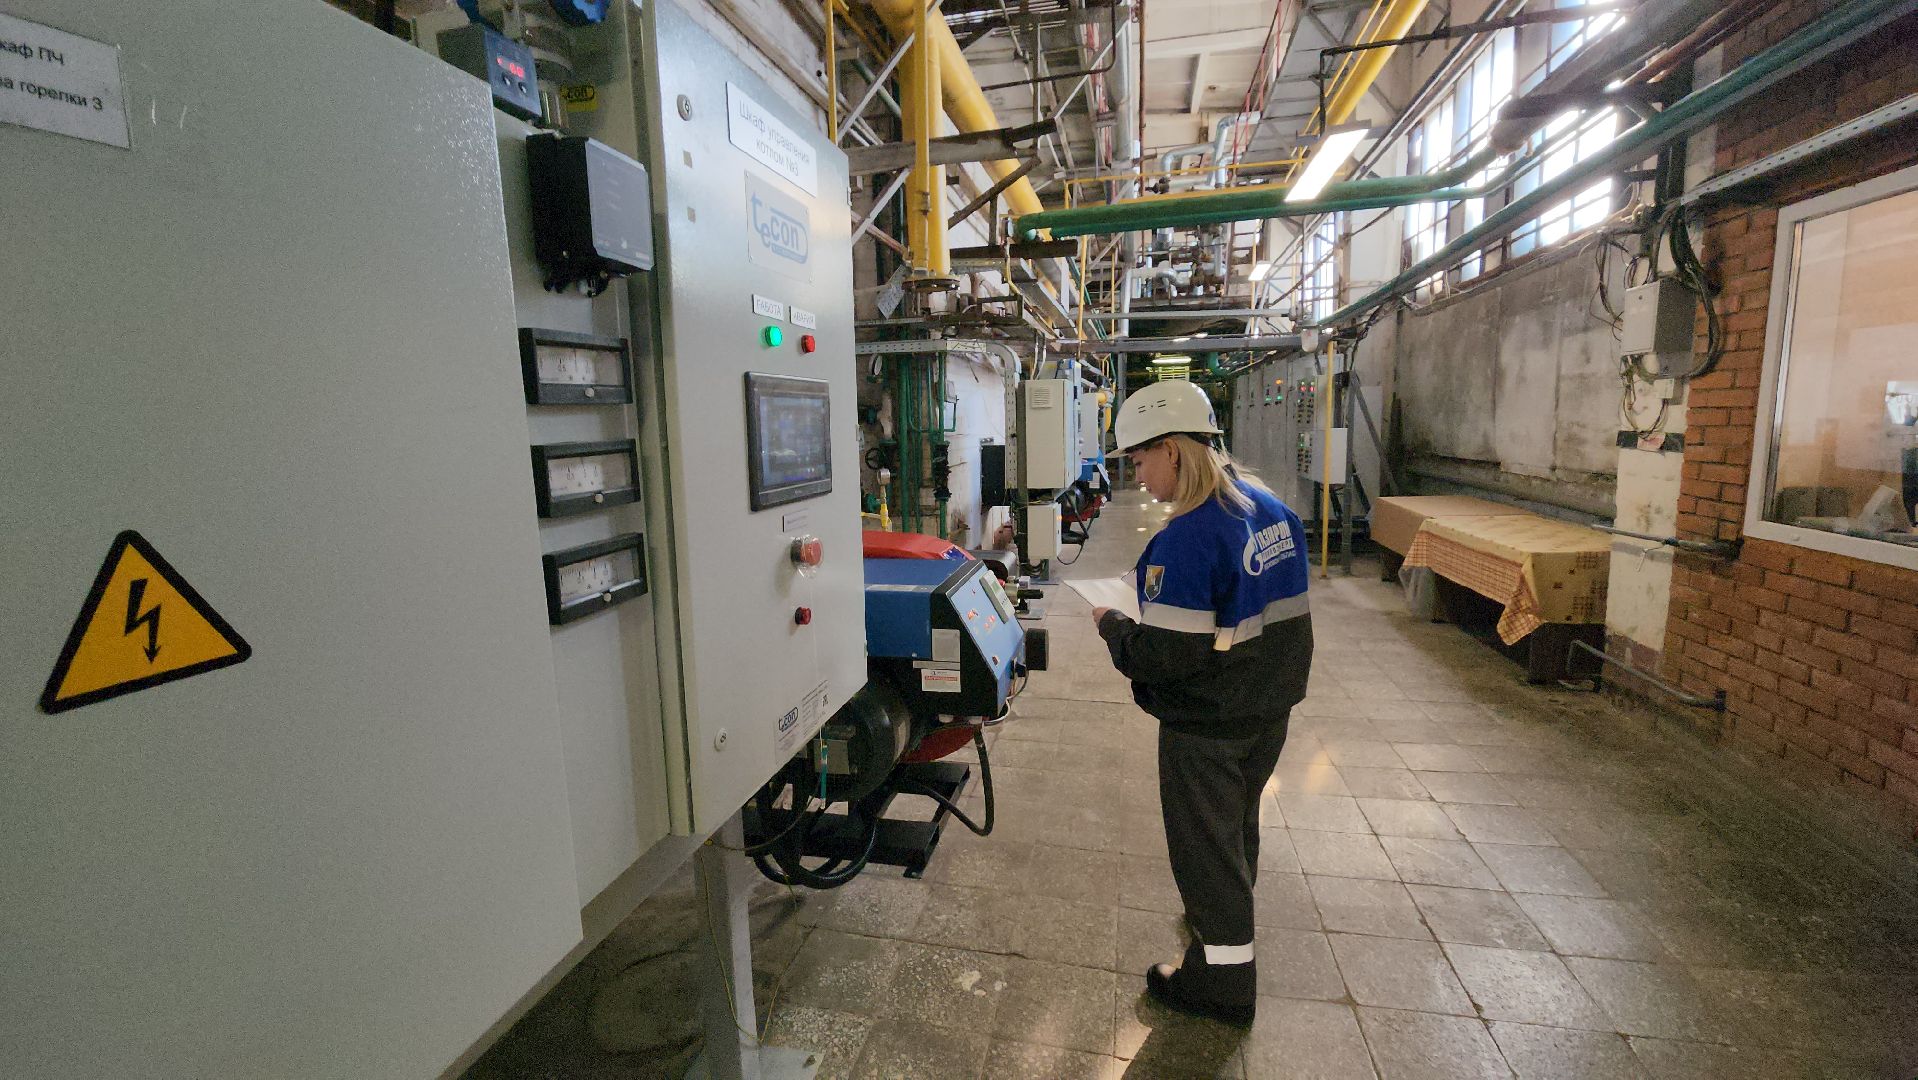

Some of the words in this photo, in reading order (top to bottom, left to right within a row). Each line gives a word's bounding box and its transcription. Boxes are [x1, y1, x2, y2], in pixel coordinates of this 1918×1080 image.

[38, 46, 65, 66] ПЧ
[20, 81, 87, 107] горелки
[92, 96, 104, 111] 3
[739, 99, 766, 134] Шкаф
[767, 124, 810, 165] управления
[755, 138, 785, 167] котлом
[751, 192, 805, 257] tecon
